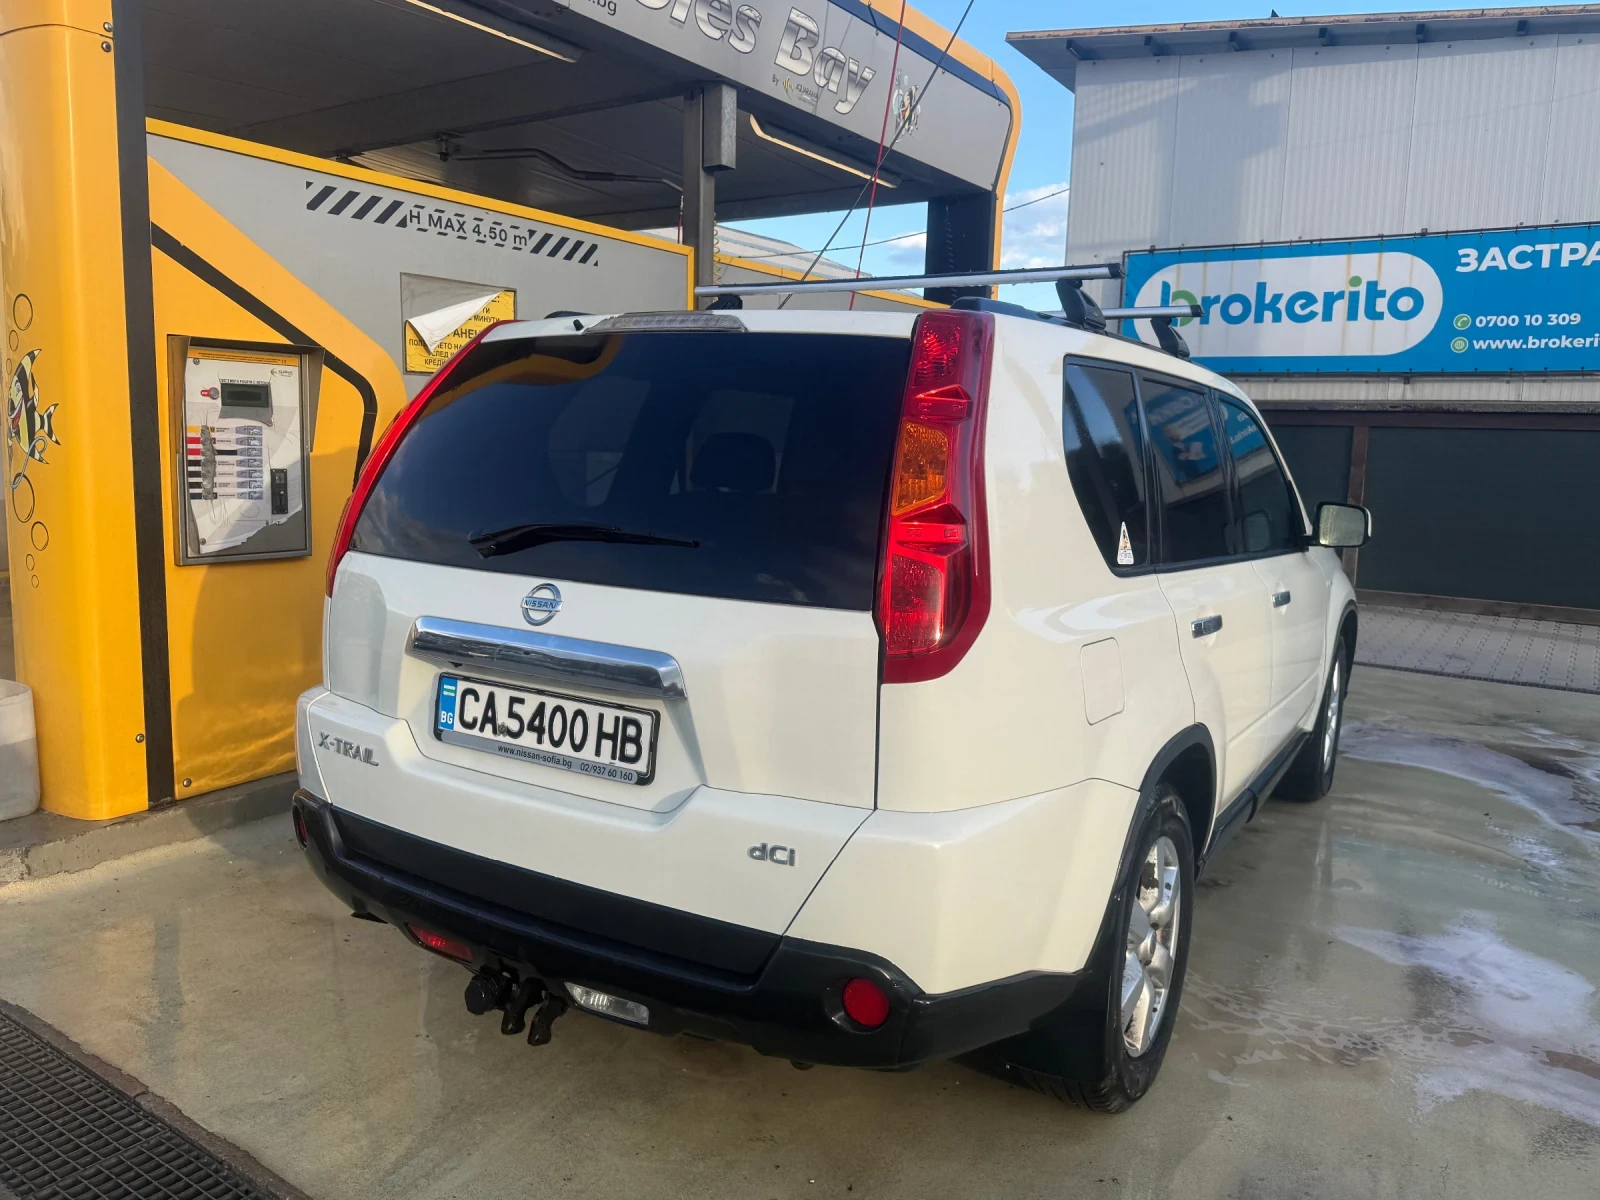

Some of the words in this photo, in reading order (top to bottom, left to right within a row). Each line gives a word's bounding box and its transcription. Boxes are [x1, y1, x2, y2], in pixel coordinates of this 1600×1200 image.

[774, 7, 876, 115] Bay
[409, 209, 421, 225] H
[428, 213, 467, 235] MAX
[472, 223, 508, 242] 4.50
[513, 234, 528, 247] m
[1160, 275, 1425, 327] brokerito
[1475, 314, 1520, 328] 0700
[1524, 313, 1543, 326] 10
[1547, 312, 1582, 326] 309
[1472, 333, 1600, 350] www.brokeri
[523, 598, 557, 610] NISSAN
[440, 711, 453, 725] BG
[319, 731, 379, 767] X-TRAIL
[497, 744, 573, 770] www.nissan-sofia.bg
[580, 762, 606, 776] 02/937
[608, 767, 617, 778] 60
[619, 770, 633, 782] 160
